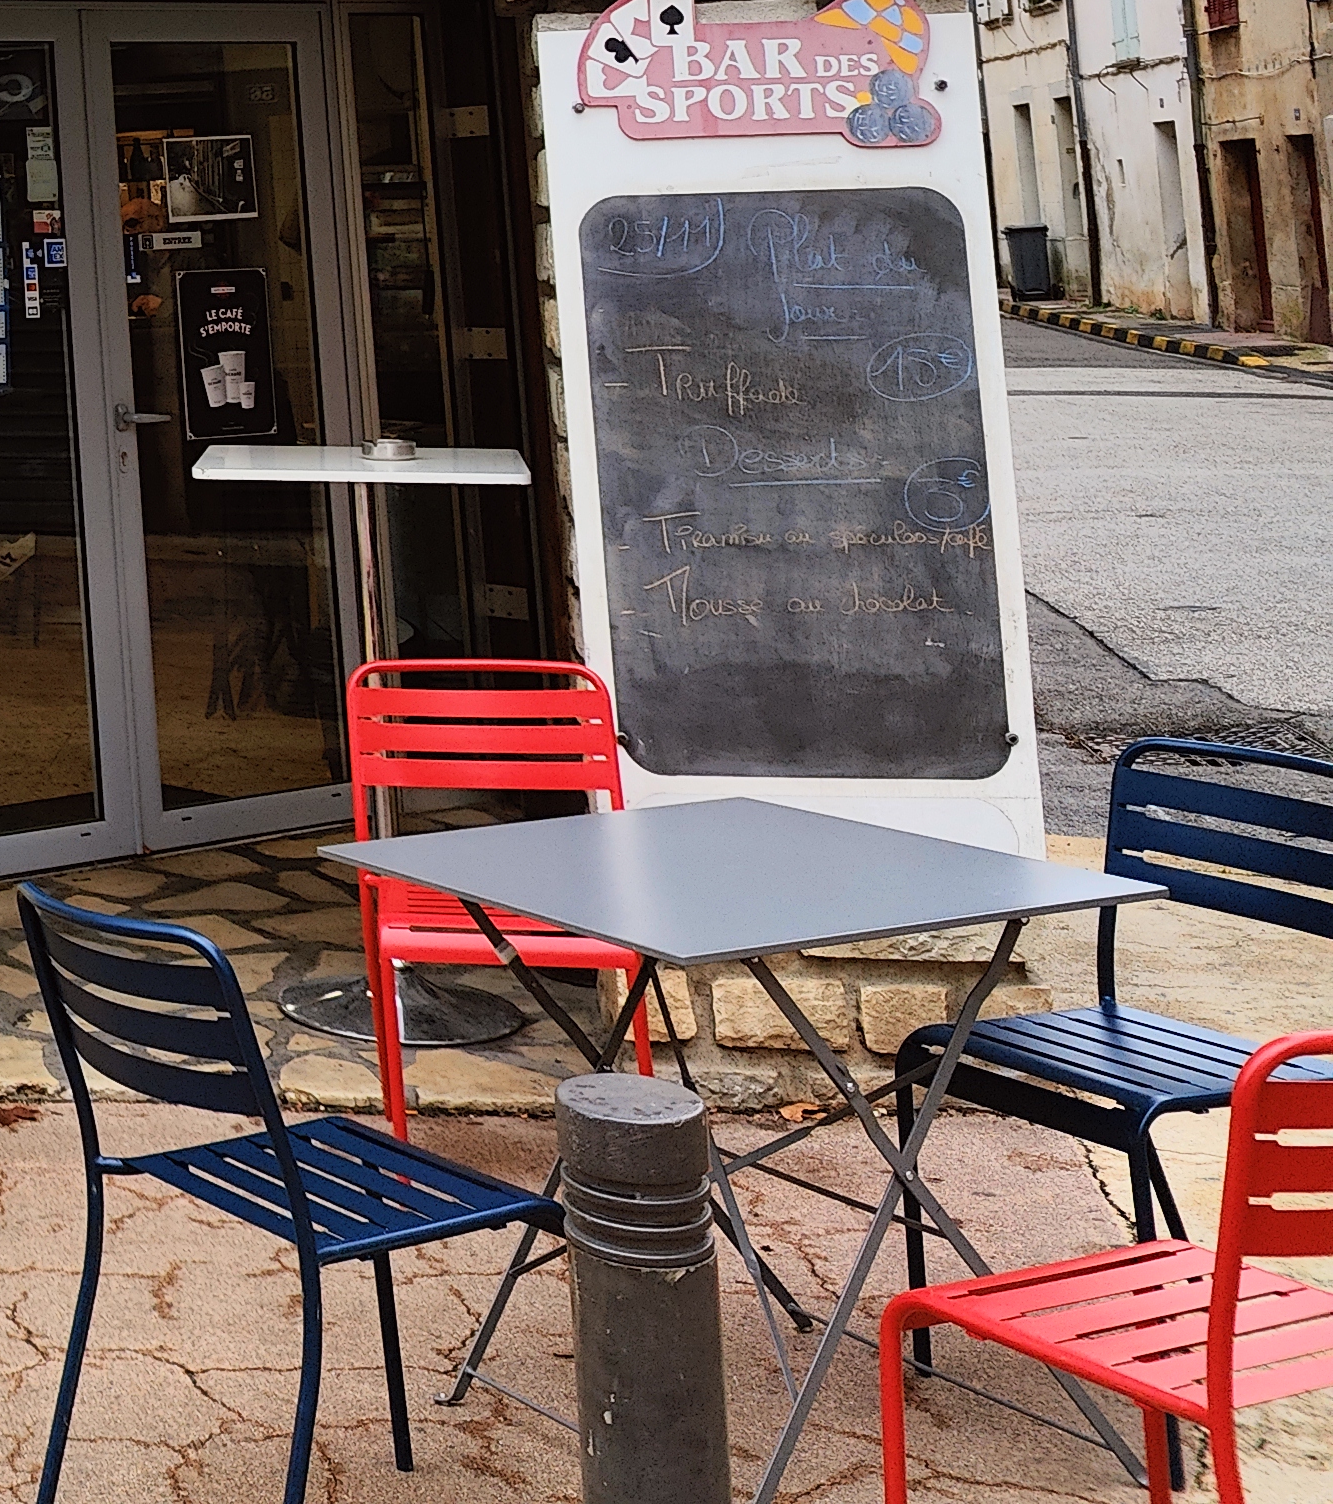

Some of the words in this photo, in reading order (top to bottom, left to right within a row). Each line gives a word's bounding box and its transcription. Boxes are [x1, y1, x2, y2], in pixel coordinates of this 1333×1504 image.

[671, 38, 808, 83] BAR
[814, 53, 879, 78] DES
[634, 80, 859, 124] SPORTS
[205, 309, 218, 321] LE
[218, 306, 244, 320] CAFÉ
[199, 321, 252, 338] S'EMPORTE
